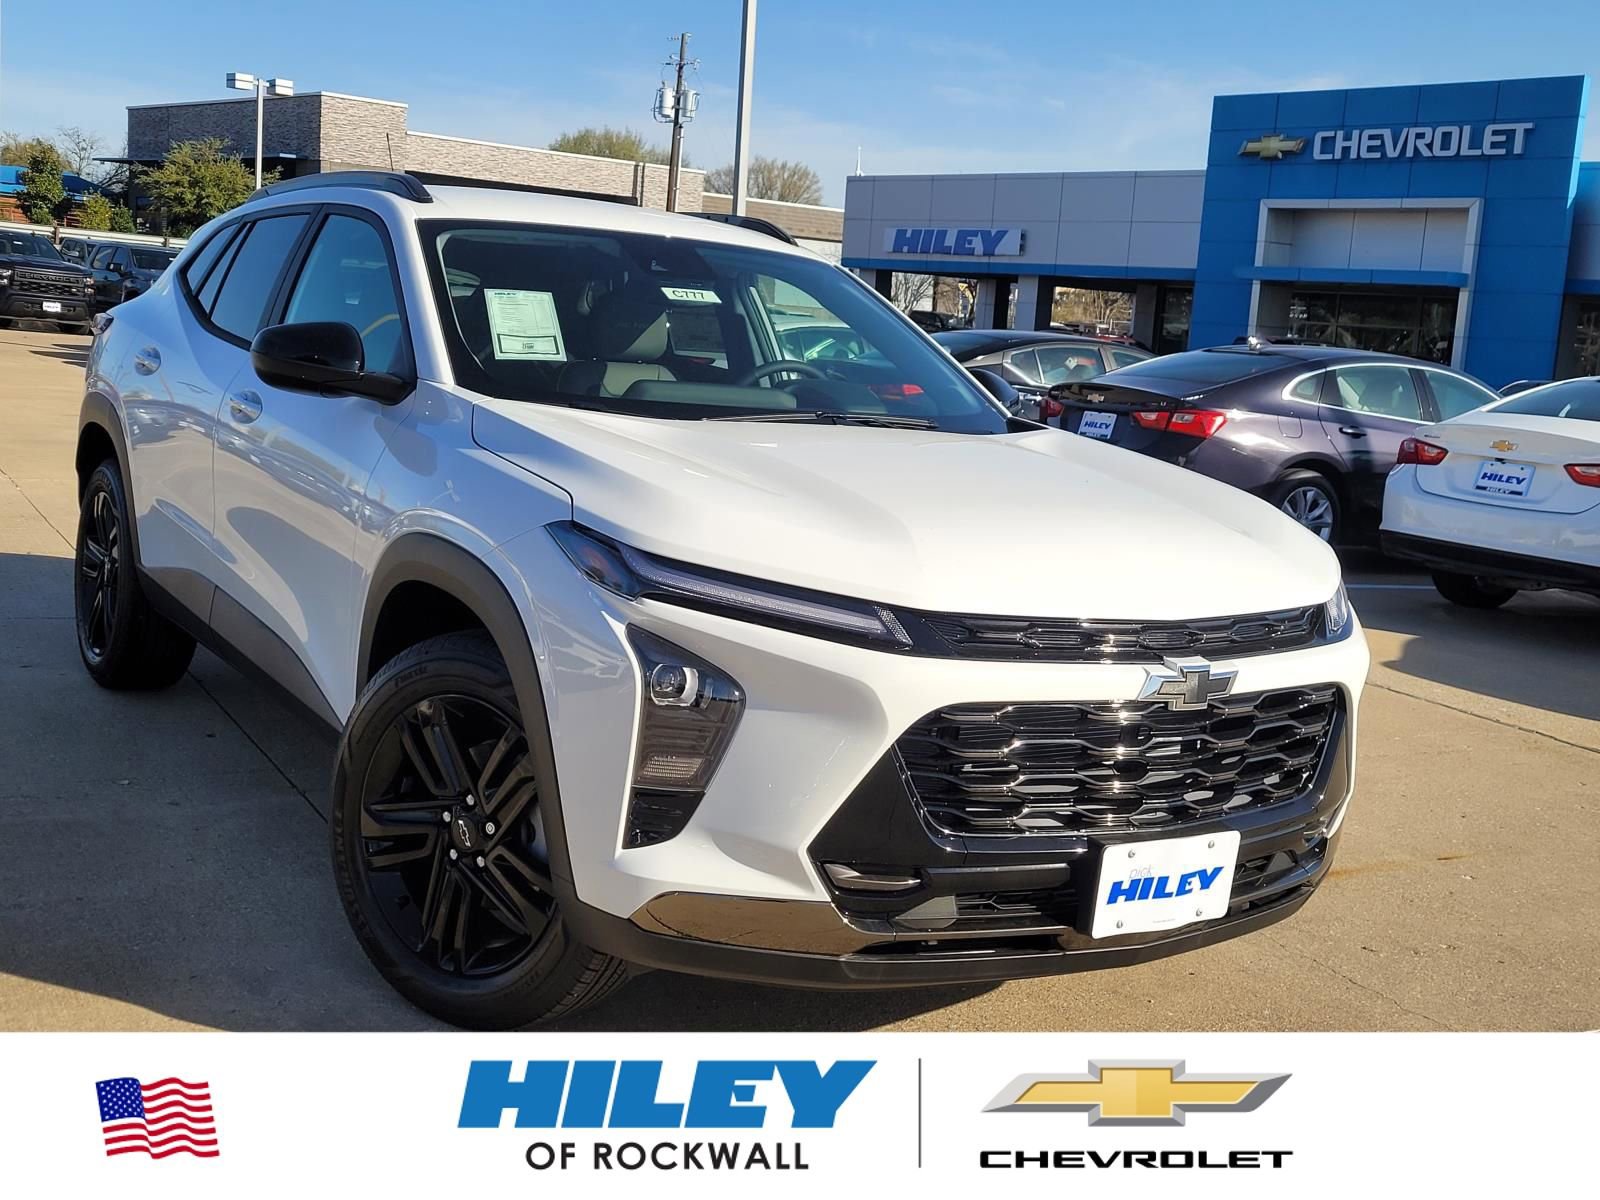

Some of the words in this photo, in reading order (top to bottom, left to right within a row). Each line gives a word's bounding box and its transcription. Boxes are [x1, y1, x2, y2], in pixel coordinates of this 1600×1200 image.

[1312, 122, 1534, 162] CHEVROLET
[892, 229, 1009, 256] HILEY
[672, 290, 705, 300] C777
[1084, 420, 1112, 430] HILEY
[1480, 471, 1528, 485] HILEY
[1106, 866, 1224, 905] HILEY
